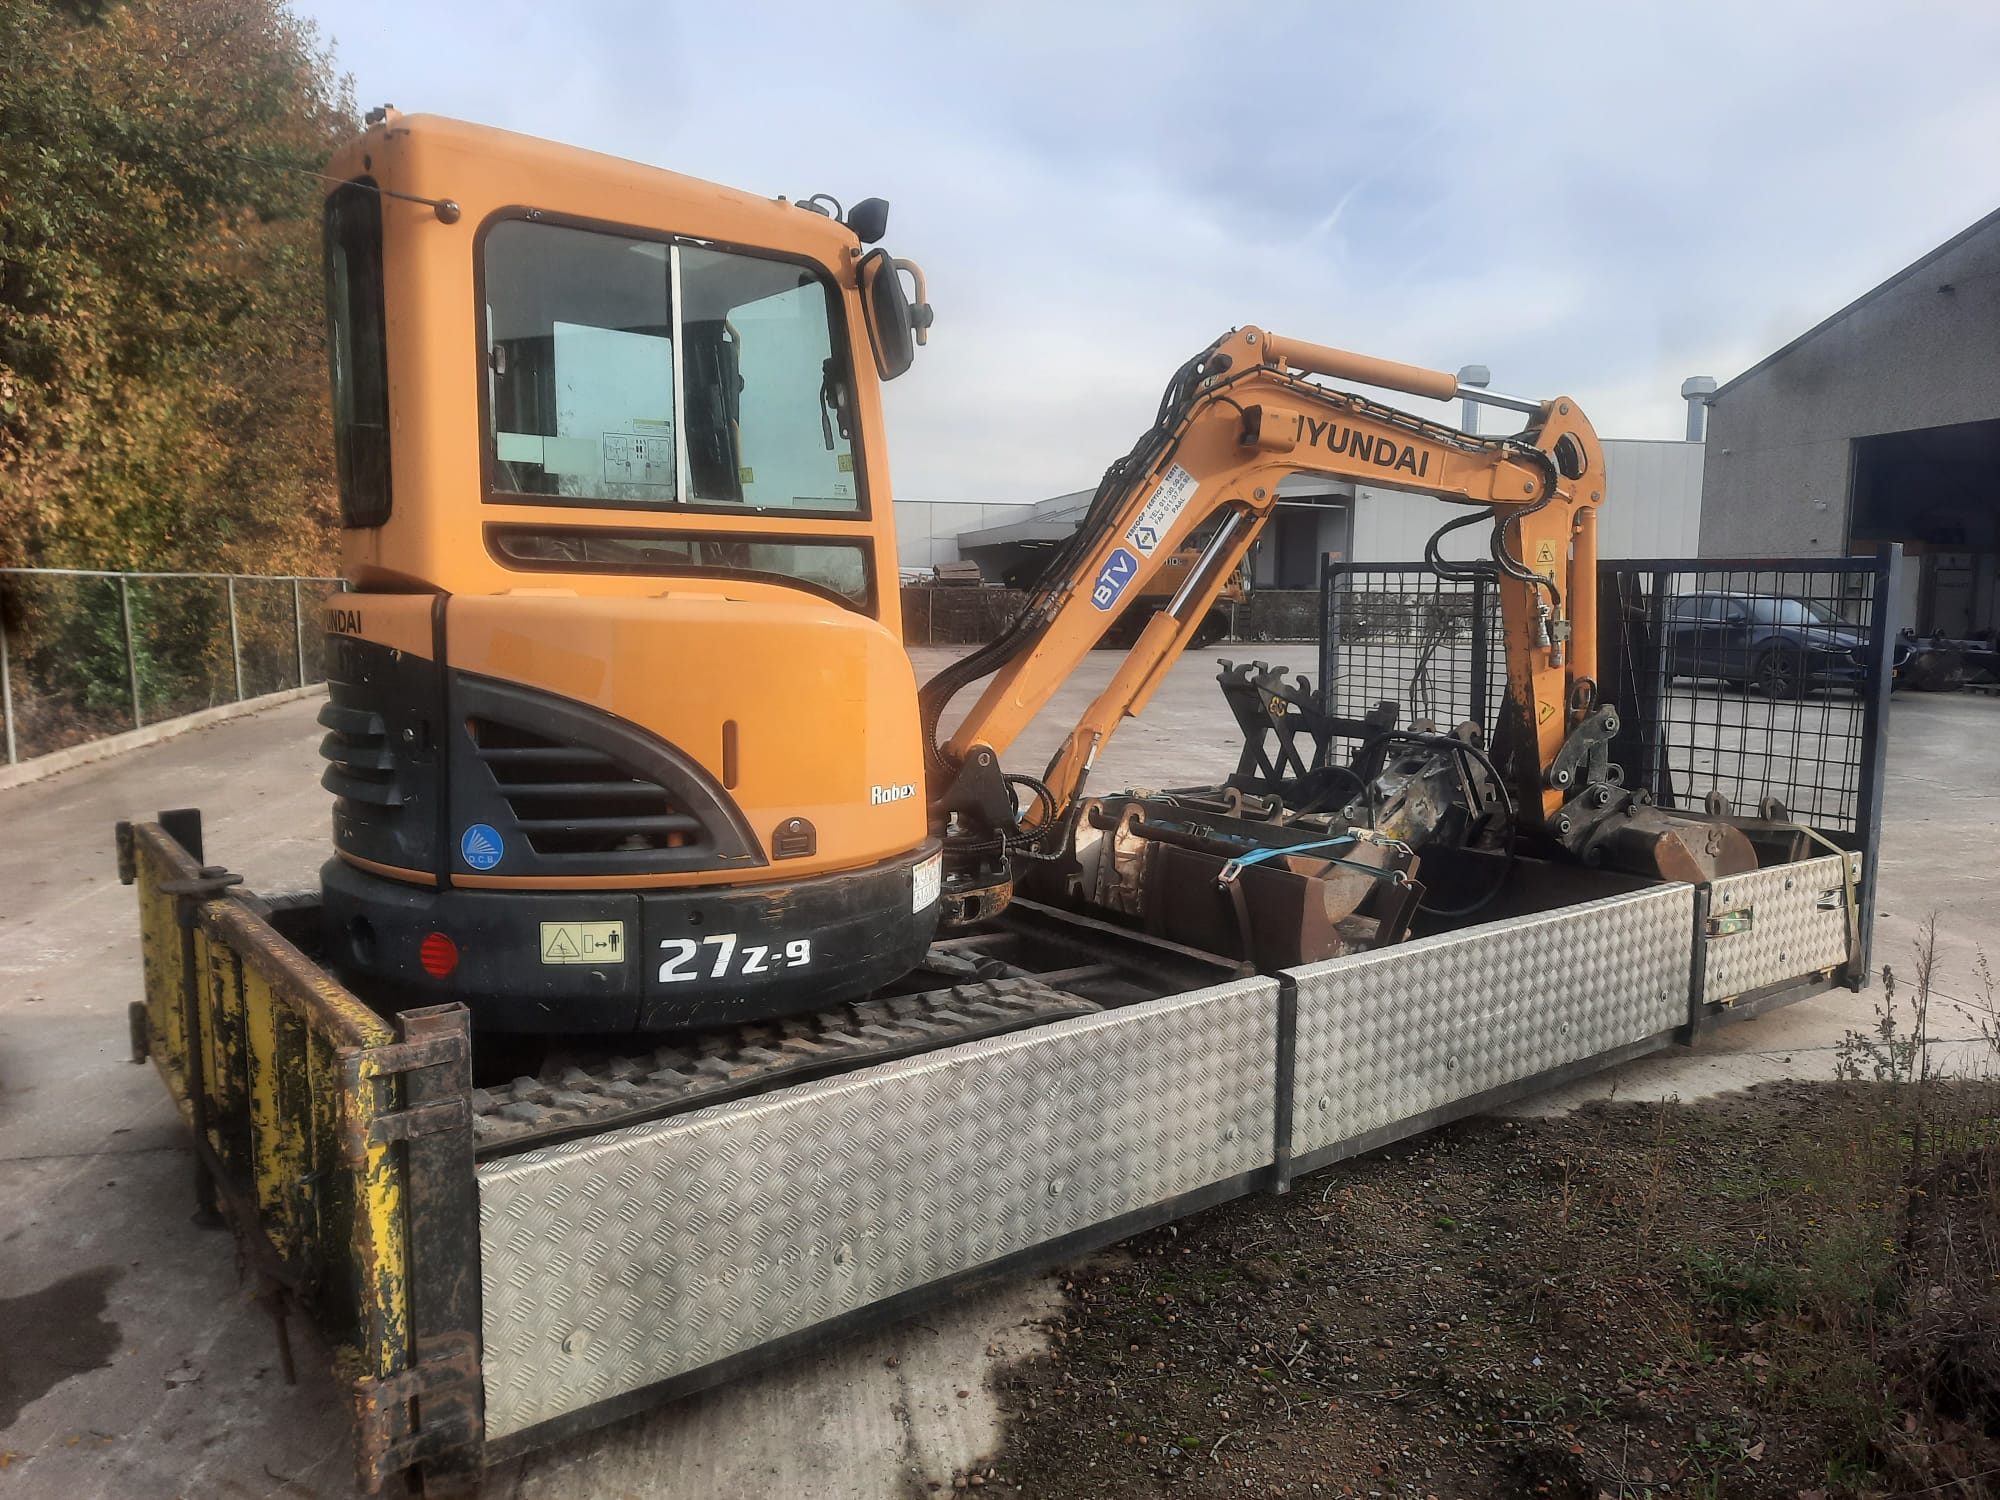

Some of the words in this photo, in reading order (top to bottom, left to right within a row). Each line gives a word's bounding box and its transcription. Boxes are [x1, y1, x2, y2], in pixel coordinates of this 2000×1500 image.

[1147, 486, 1165, 510] SERVICE
[1171, 497, 1186, 514] PAAL
[1154, 512, 1166, 526] FAX
[1093, 556, 1129, 605] BTV
[326, 609, 362, 634] UNDAI
[871, 782, 917, 806] Robex
